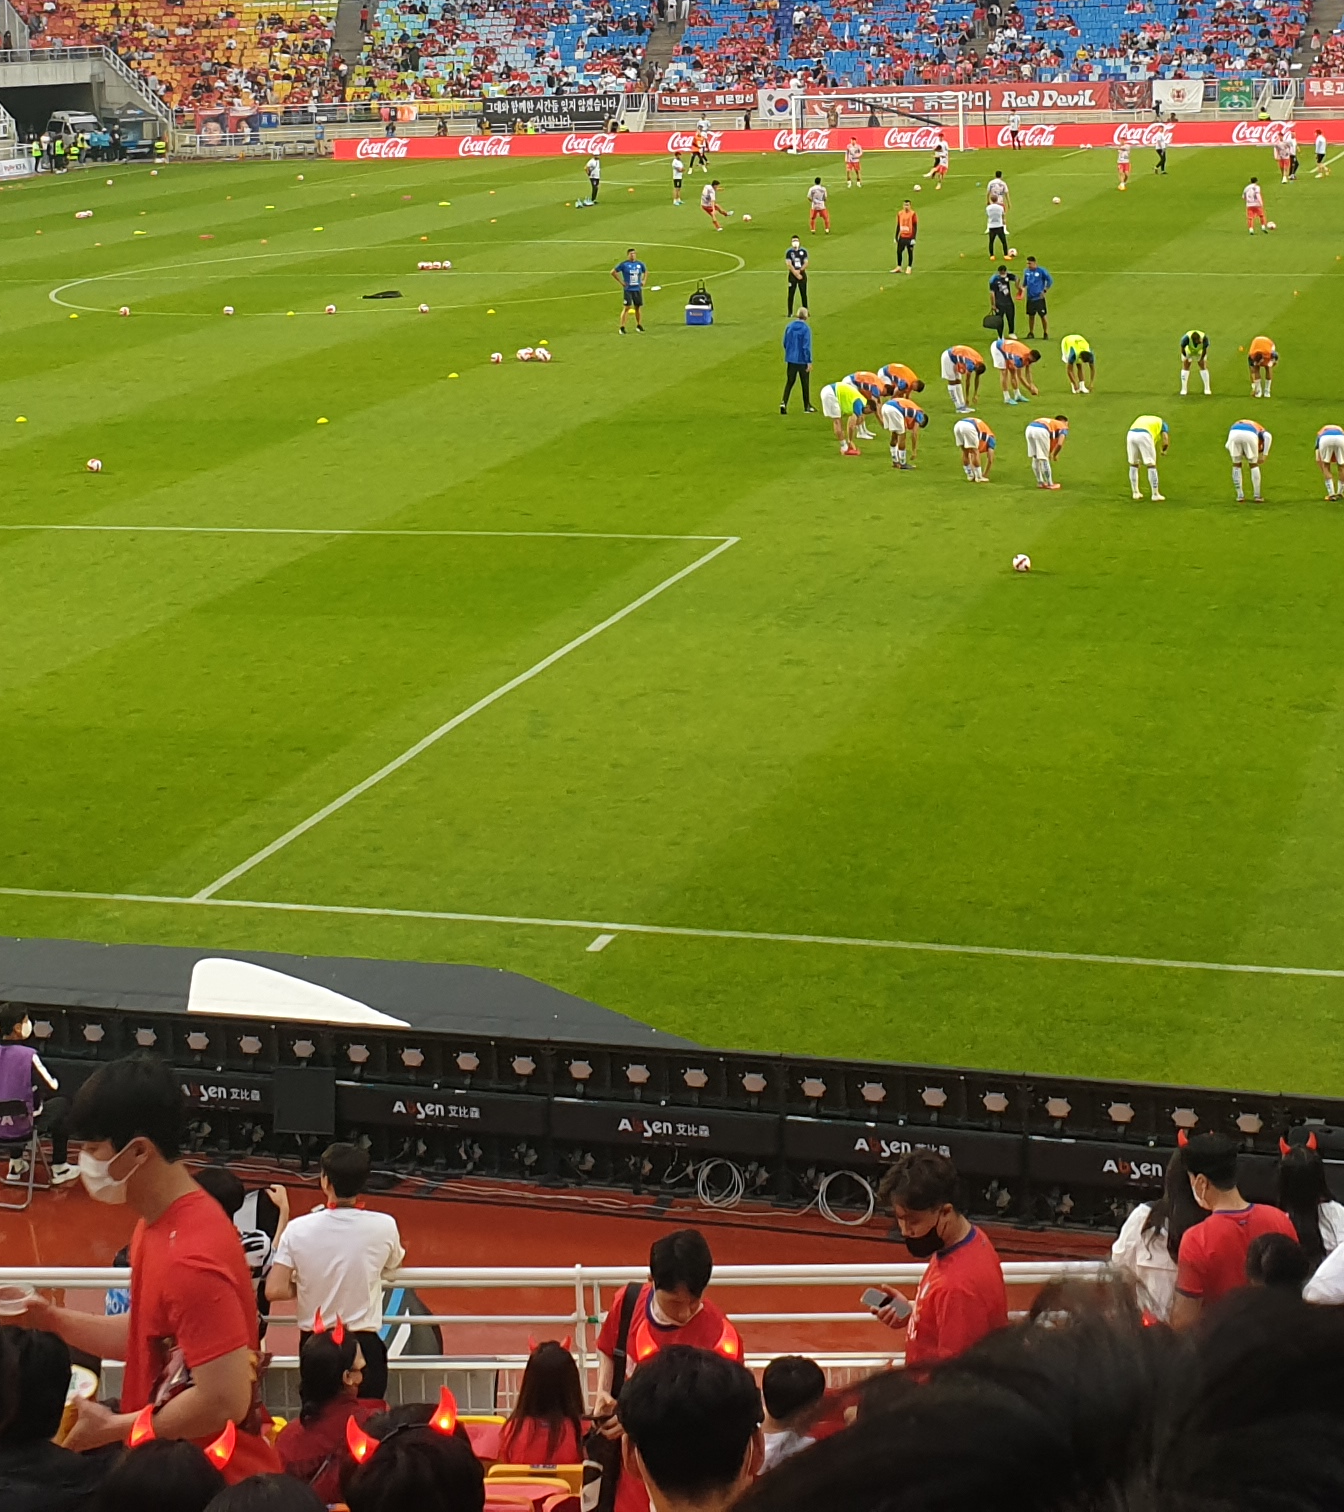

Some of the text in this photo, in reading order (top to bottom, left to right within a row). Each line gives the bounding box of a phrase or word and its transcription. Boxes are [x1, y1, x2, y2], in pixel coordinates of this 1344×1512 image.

[486, 101, 509, 114] 그대와
[511, 100, 534, 114] 함께한
[560, 99, 576, 112] 잊지
[578, 96, 618, 113] 않겠습니다.
[661, 96, 699, 106] 대한민국
[1002, 90, 1039, 108] Red
[1103, 1157, 1163, 1179] Absen
